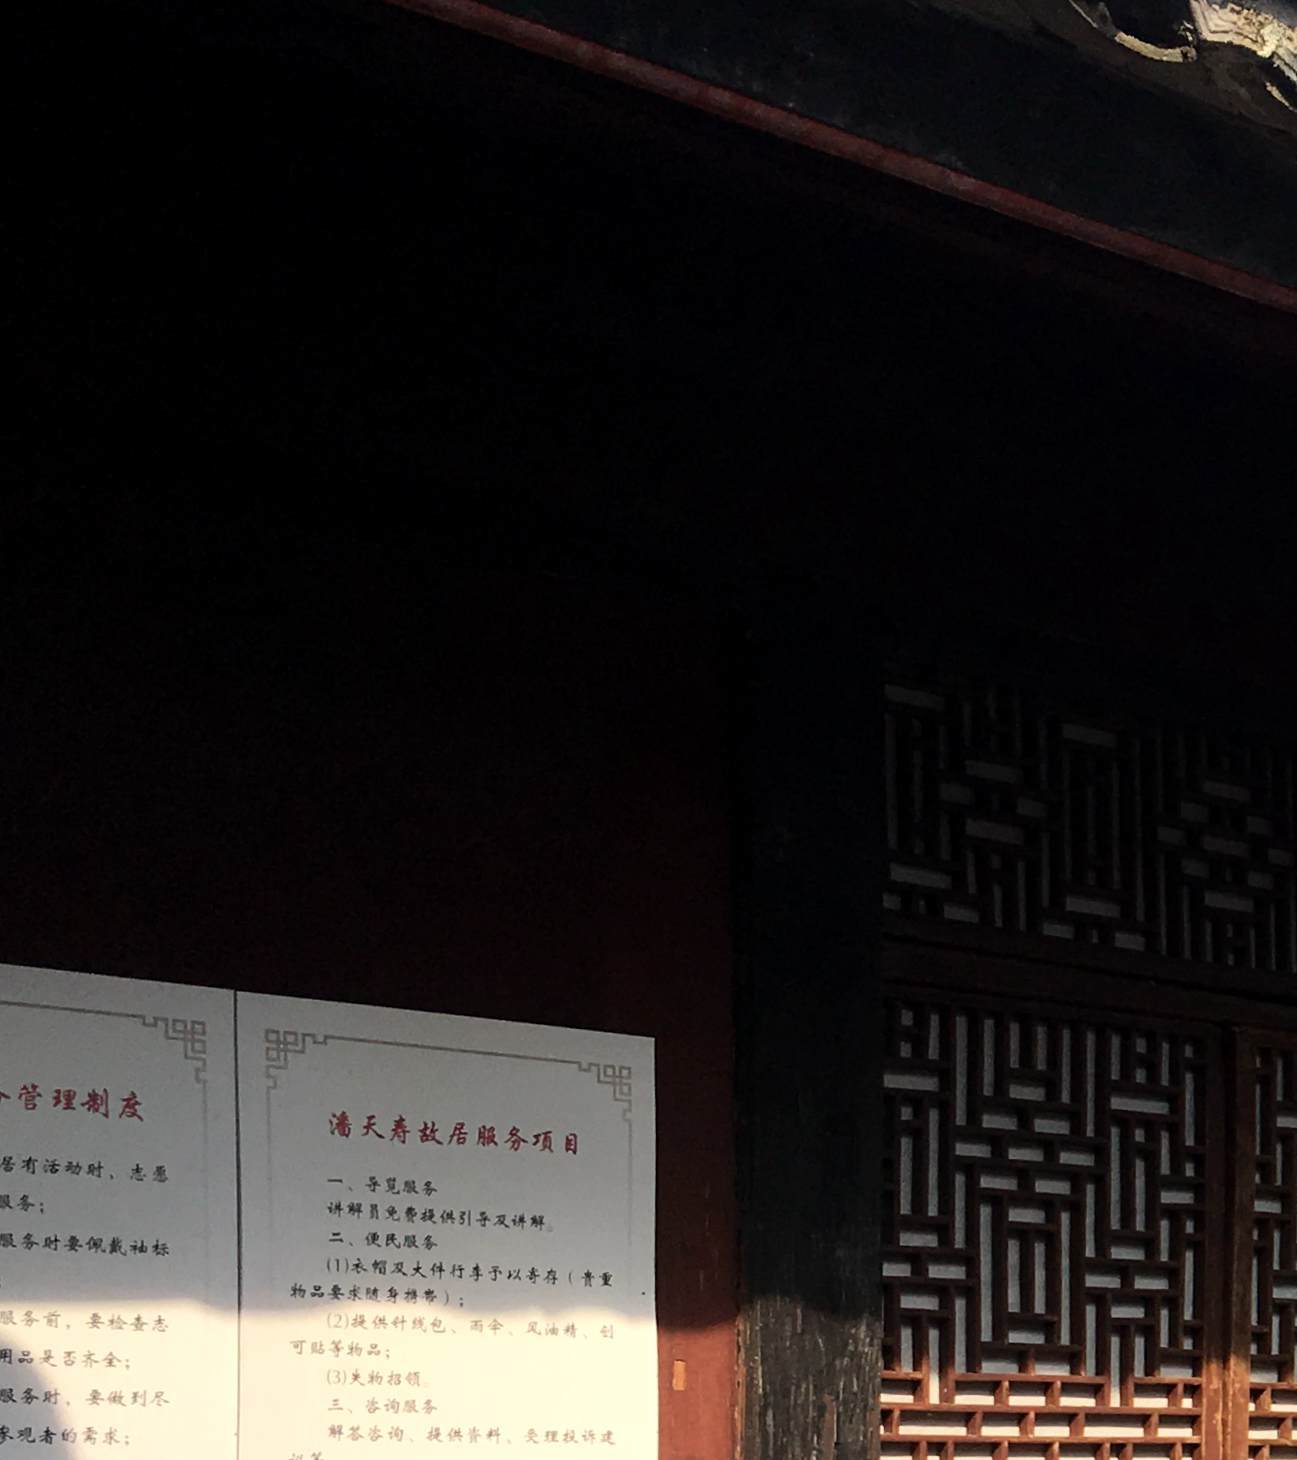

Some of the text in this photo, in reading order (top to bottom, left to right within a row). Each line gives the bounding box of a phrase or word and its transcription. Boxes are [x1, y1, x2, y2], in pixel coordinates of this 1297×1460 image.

[328, 1111, 580, 1154] 潘天寿故居服务项目
[327, 1176, 438, 1196] 一、导览服务
[328, 1232, 438, 1251] 二、便民服务
[327, 1398, 438, 1415] 三、咨询服务
